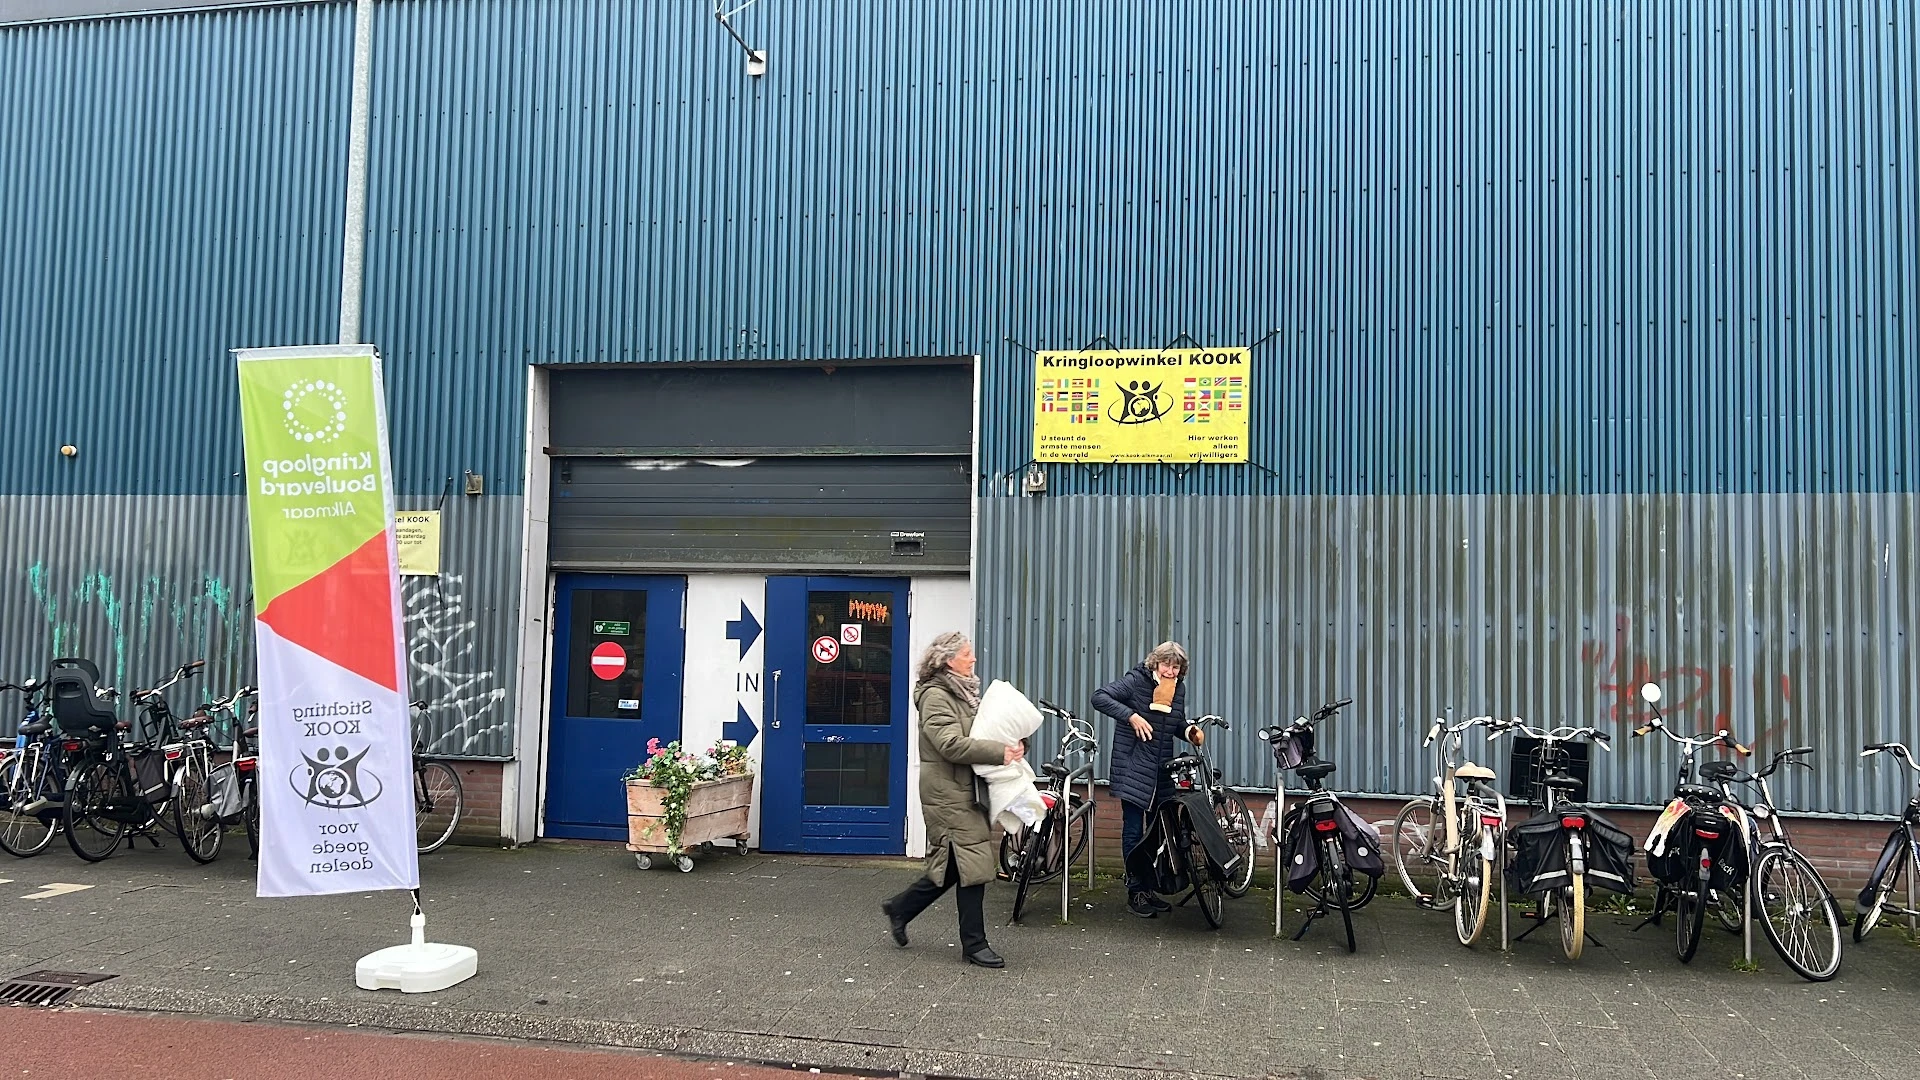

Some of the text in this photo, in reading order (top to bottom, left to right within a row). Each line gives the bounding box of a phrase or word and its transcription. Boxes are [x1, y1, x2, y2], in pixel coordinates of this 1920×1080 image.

[1043, 352, 1242, 369] Kringloopwinkel KOOK
[736, 672, 759, 692] IN
